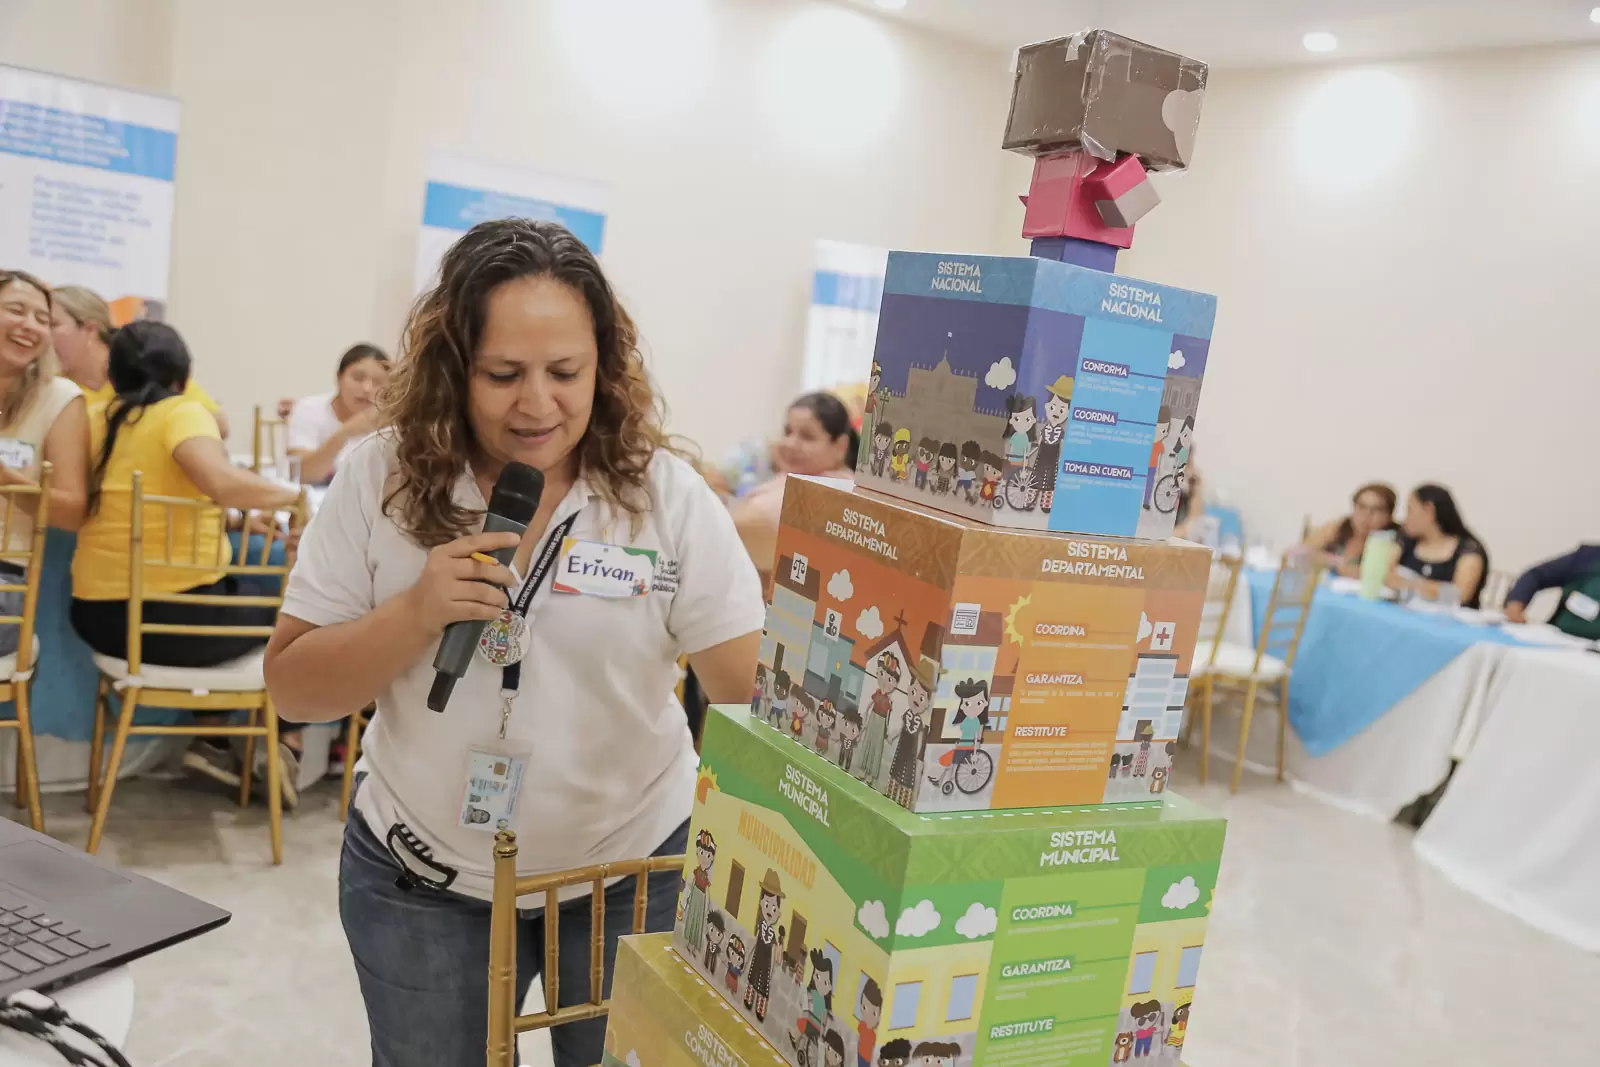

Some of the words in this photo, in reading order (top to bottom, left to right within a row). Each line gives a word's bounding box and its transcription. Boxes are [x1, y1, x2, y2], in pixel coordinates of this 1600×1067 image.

[937, 261, 981, 277] SISTEMA
[931, 277, 983, 294] NACIONAL
[1108, 282, 1161, 306] SISTEMA
[1101, 299, 1163, 323] NACIONAL
[1082, 360, 1128, 377] CONFORMA
[1073, 409, 1116, 424] COORDINA
[1064, 462, 1088, 473] TOMA
[1088, 466, 1101, 475] EN
[1101, 467, 1132, 478] CUENTA
[842, 507, 886, 538] SISTEMA
[553, 524, 567, 543] SOCIAL
[825, 520, 898, 560] DEPARTAMENTAL
[1067, 541, 1128, 562] SISTEMA
[567, 555, 634, 581] Erivan
[1041, 558, 1145, 580] DEPARTAMENTAL
[1035, 623, 1086, 637] COORDINA
[1025, 673, 1084, 685] GARANTIZA
[1014, 726, 1068, 737] RESTITUYE
[785, 763, 829, 806] SISTEMA
[778, 778, 830, 828] MUNICIPAL
[1050, 829, 1117, 848] SISTEMA
[1039, 846, 1120, 867] MUNICIPAL
[1012, 904, 1073, 921] COORDINA
[1001, 959, 1072, 977] GARANTIZA
[990, 1018, 1054, 1039] RESTITUYE
